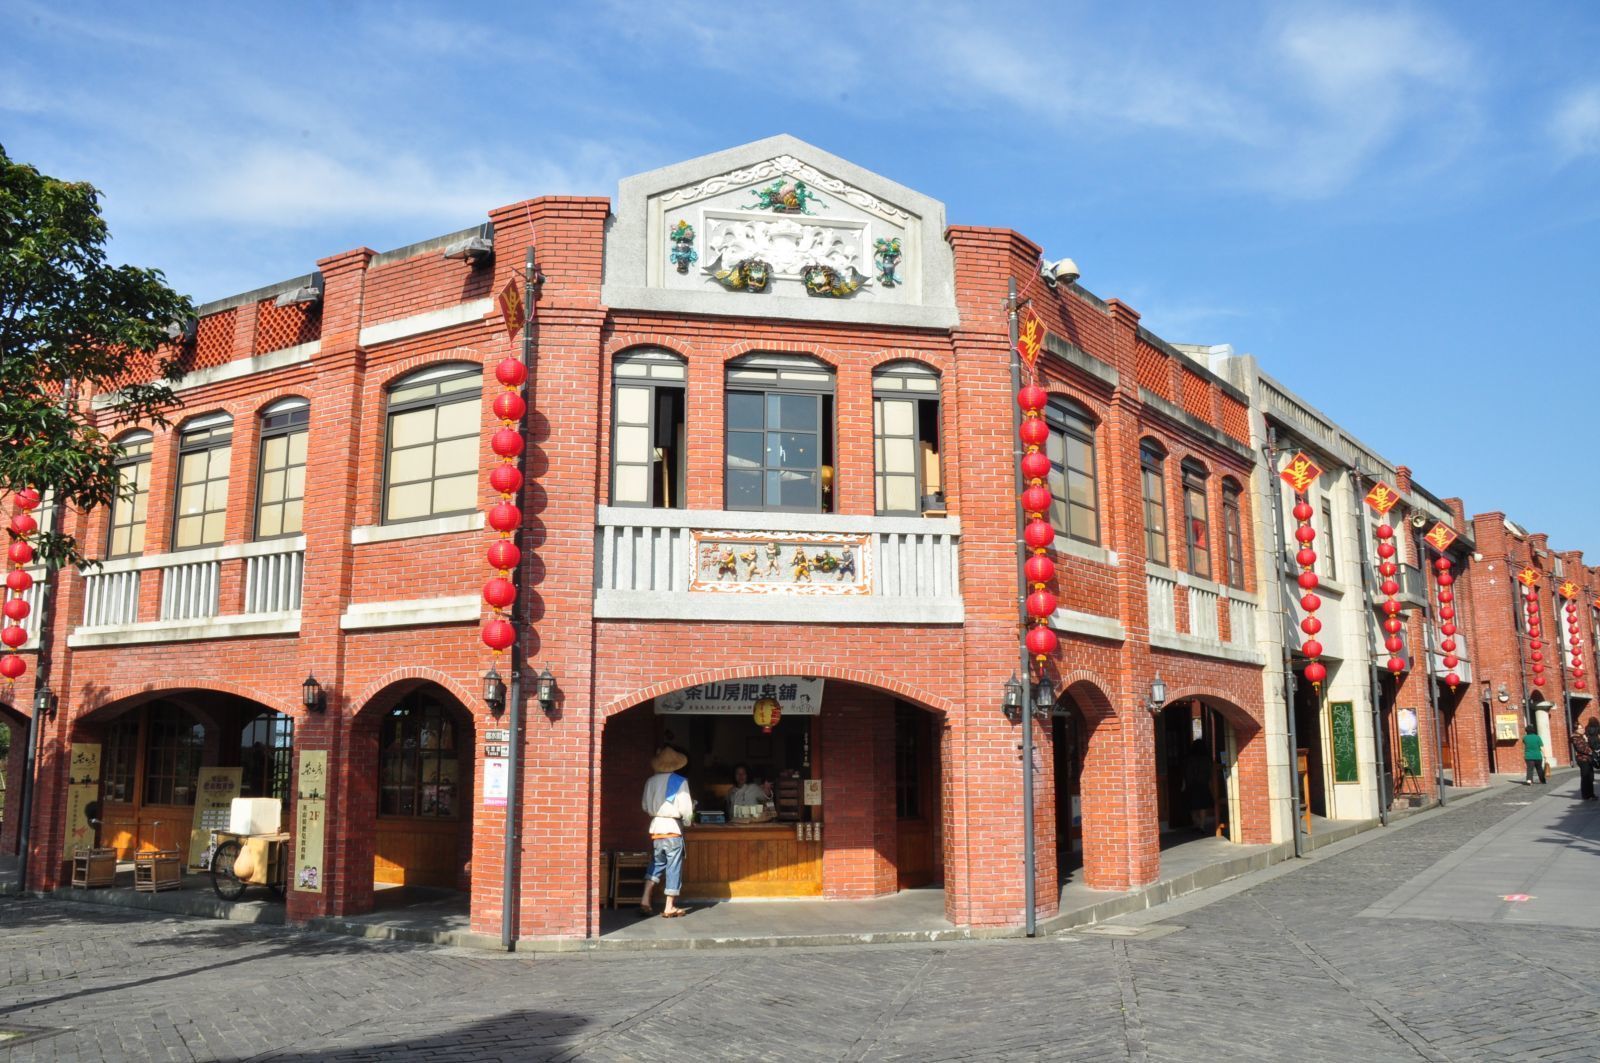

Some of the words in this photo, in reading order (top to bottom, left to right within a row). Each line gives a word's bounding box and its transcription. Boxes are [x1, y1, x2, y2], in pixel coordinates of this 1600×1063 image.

[1019, 319, 1041, 361] 春
[1284, 460, 1313, 487] 春
[1366, 486, 1395, 511] 春
[1427, 526, 1451, 548] 春
[309, 810, 320, 821] 2F
